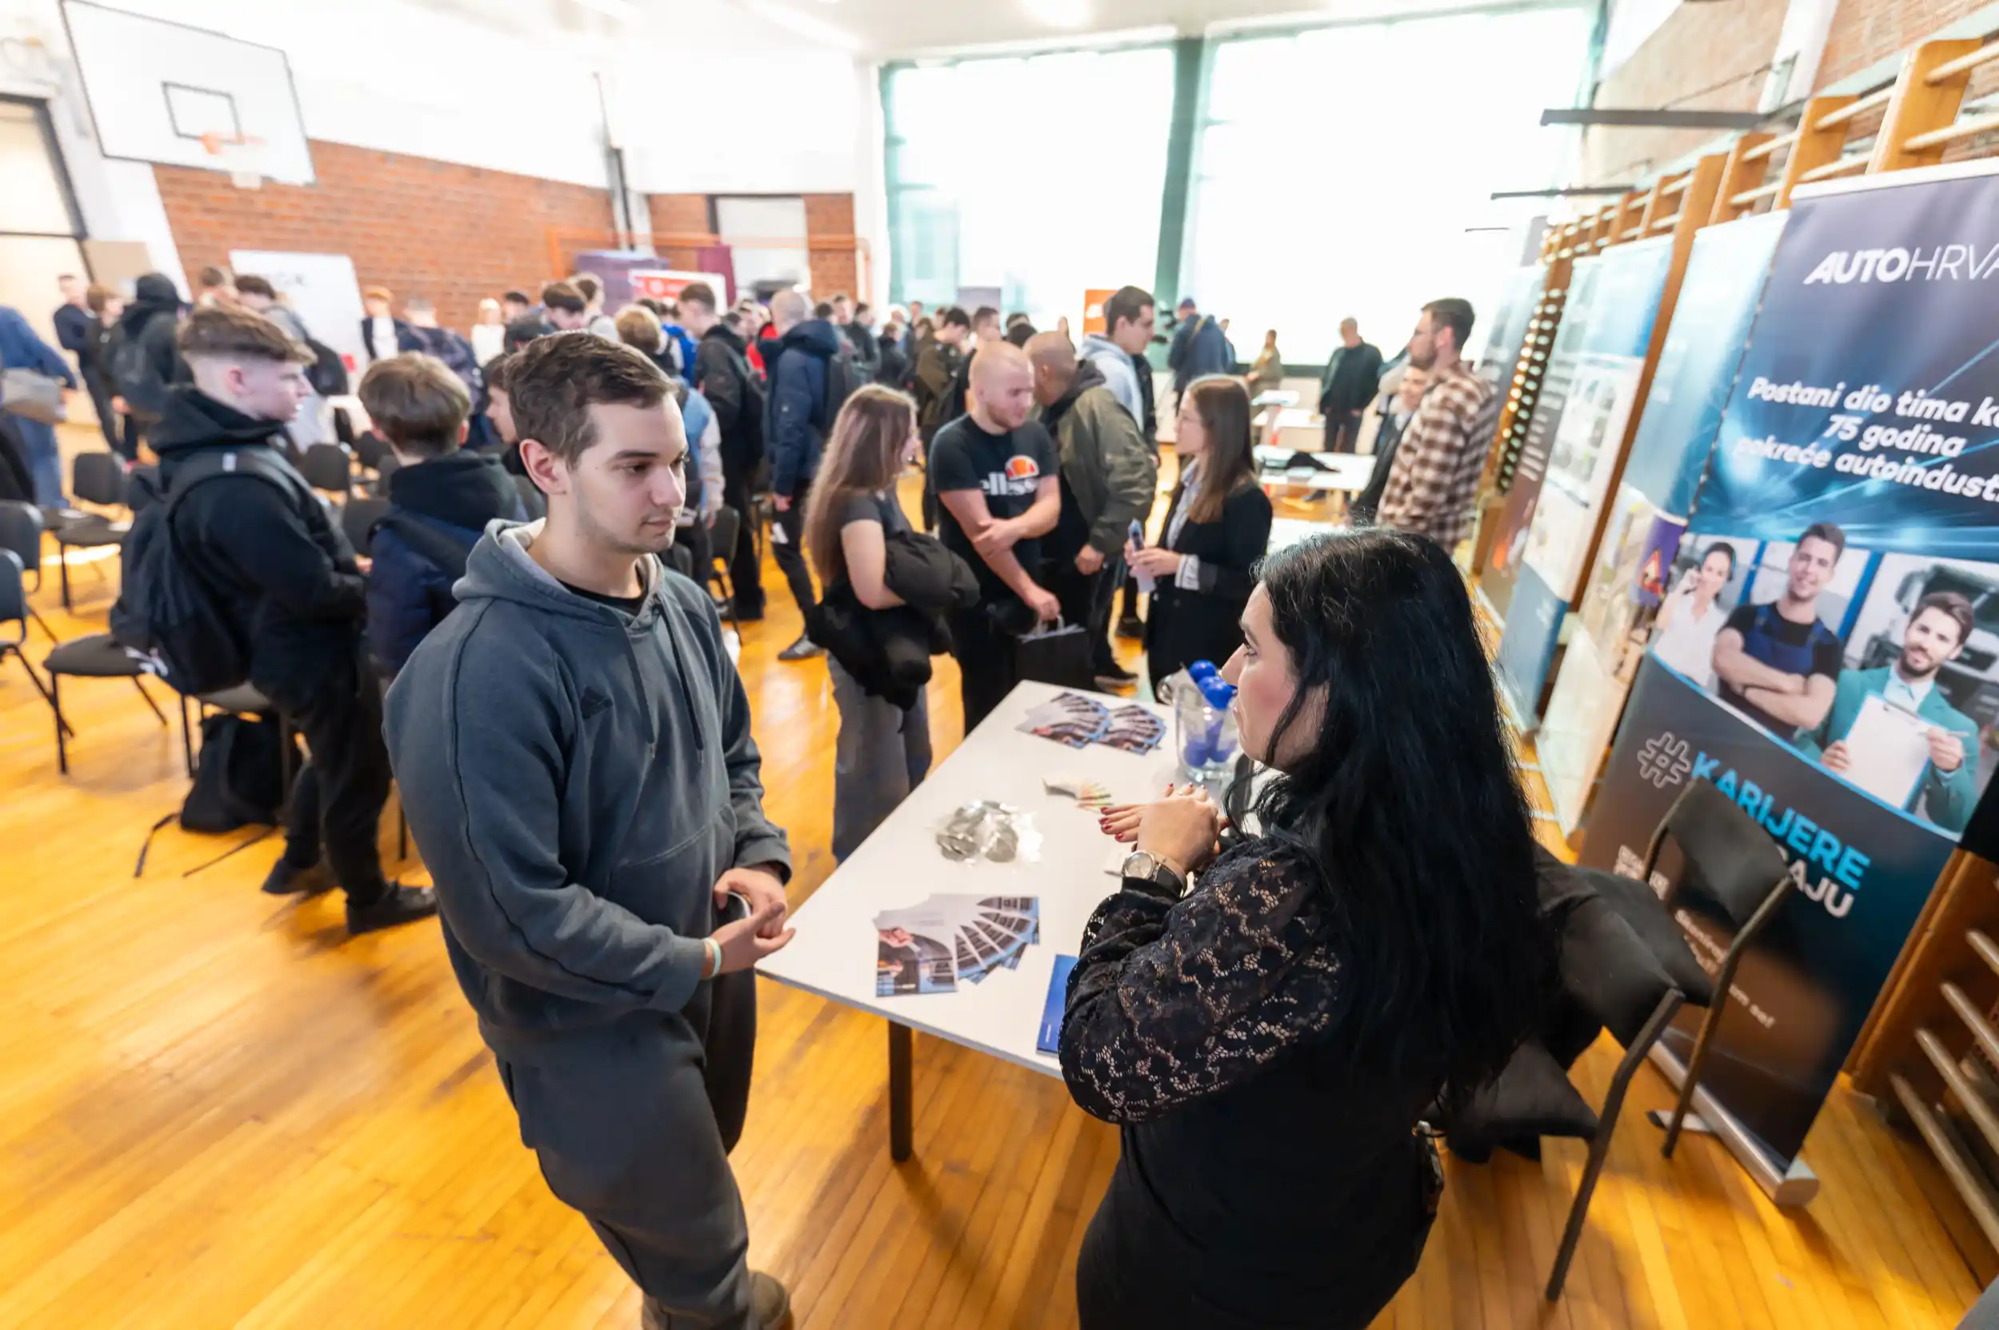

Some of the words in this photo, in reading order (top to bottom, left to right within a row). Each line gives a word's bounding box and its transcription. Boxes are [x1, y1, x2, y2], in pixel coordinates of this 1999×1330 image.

[1747, 376, 1846, 408] Postani
[1843, 384, 1892, 413] dio
[1895, 389, 1971, 422] tima
[1823, 414, 1863, 441] 75
[1858, 423, 1967, 458] godina
[1834, 450, 1999, 502] autoindust
[1691, 751, 1871, 890] KARIJERE
[1775, 844, 1855, 918] AJU
